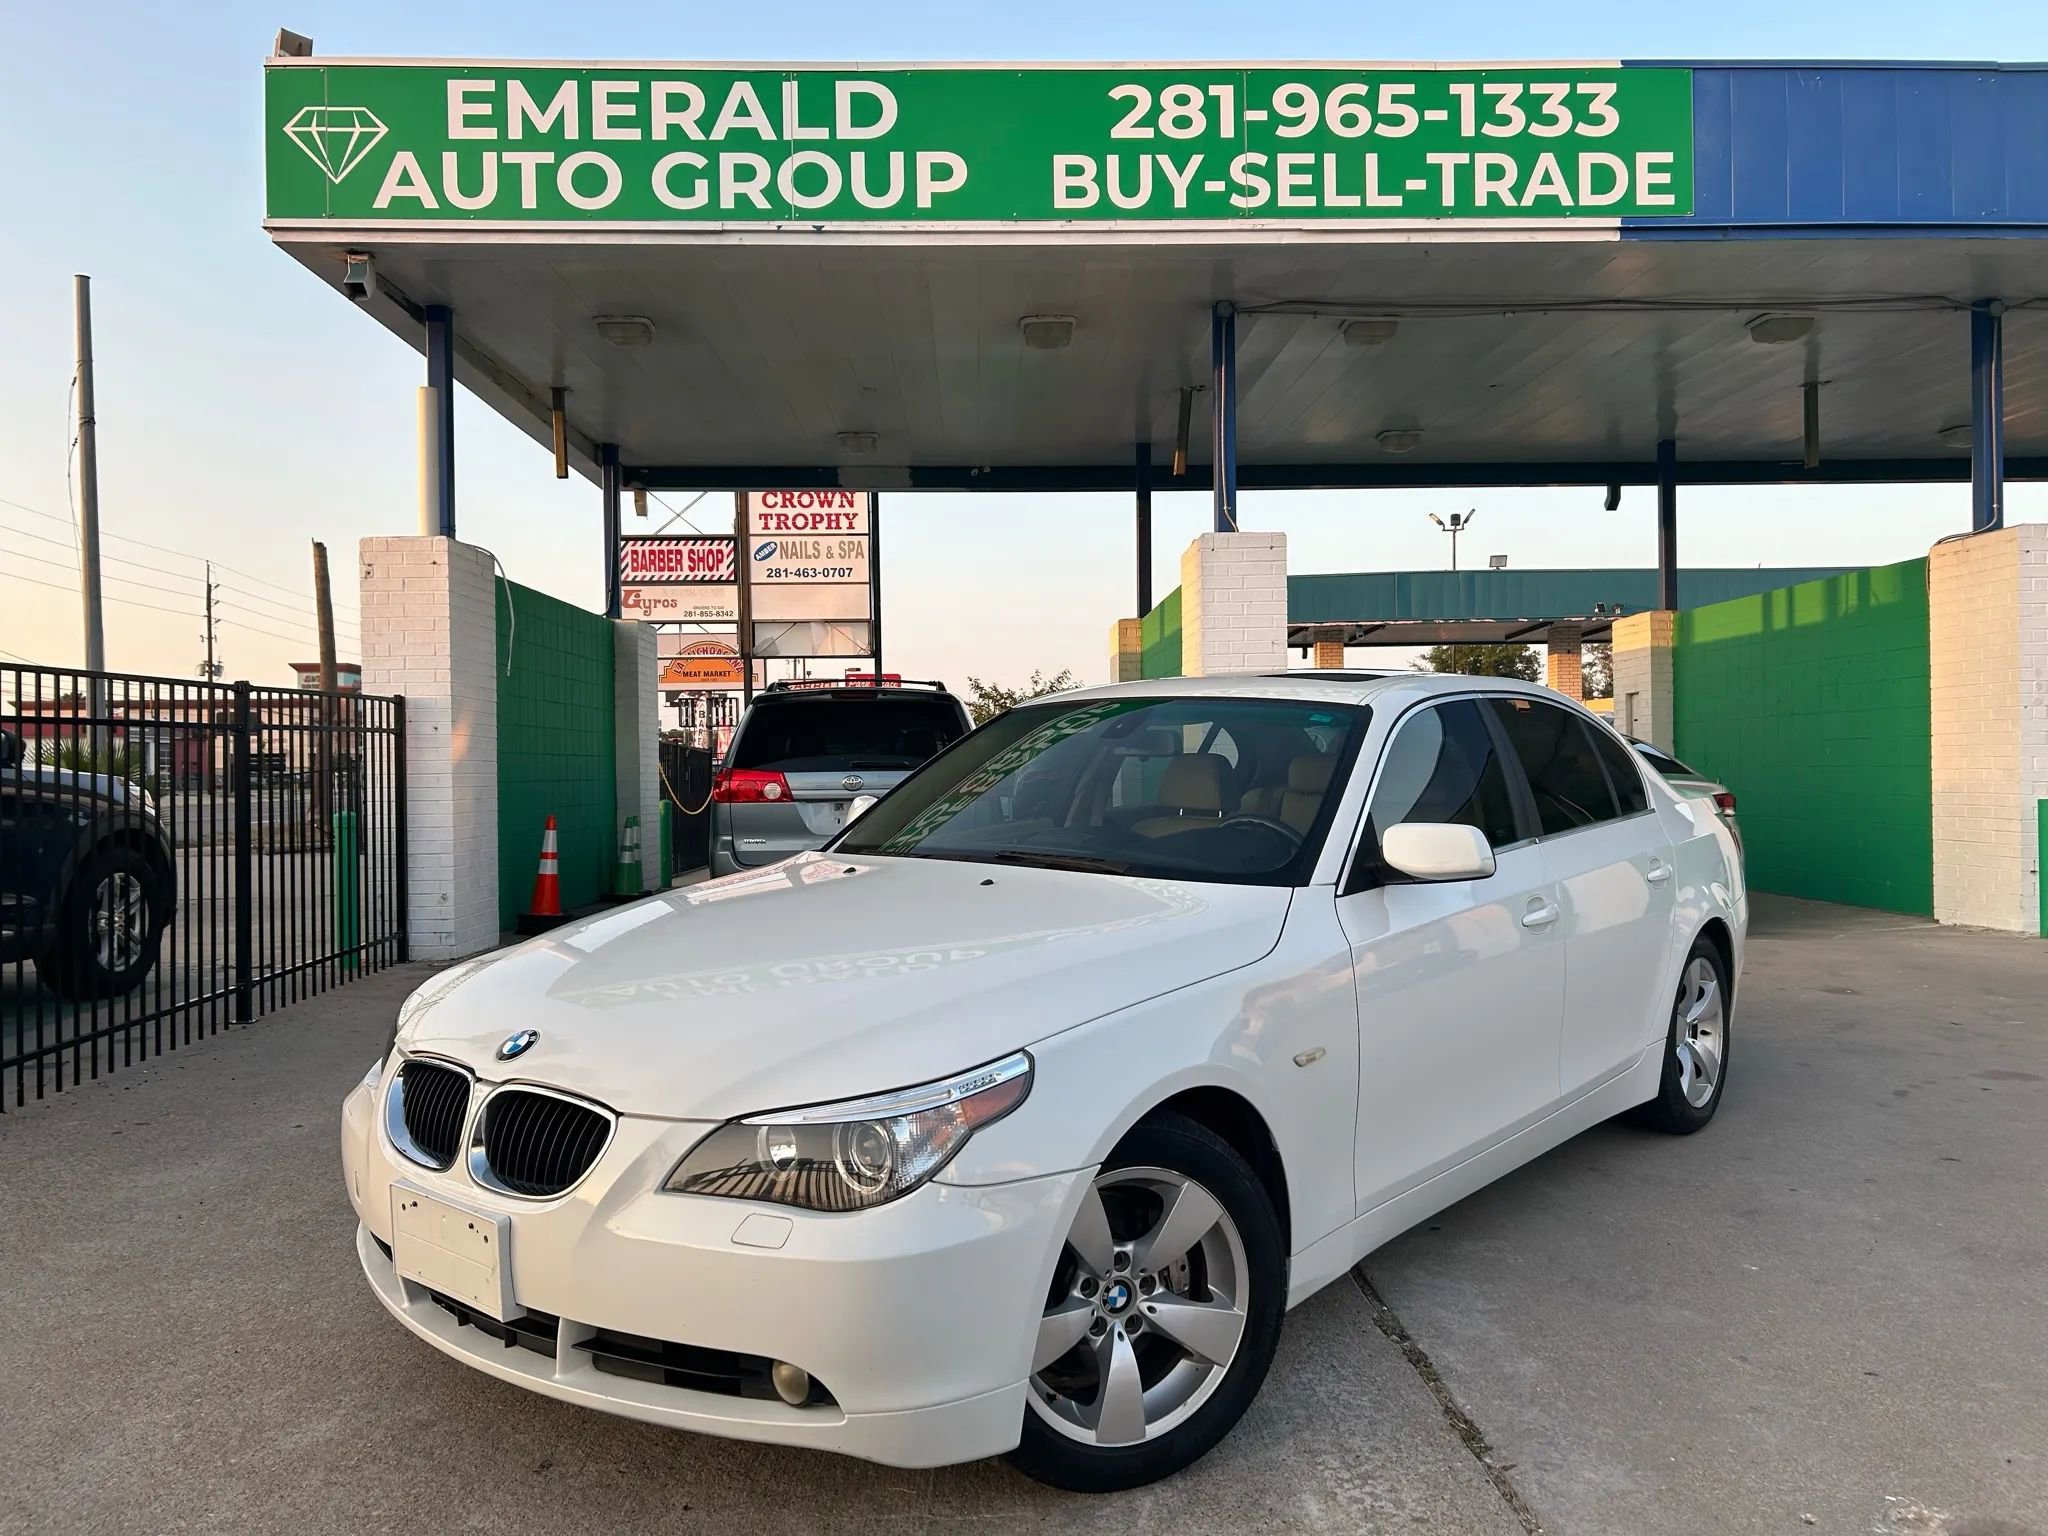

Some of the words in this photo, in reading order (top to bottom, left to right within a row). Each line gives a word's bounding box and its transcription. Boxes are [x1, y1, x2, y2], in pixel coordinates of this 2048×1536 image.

[446, 79, 899, 140] EMERALD
[1107, 82, 1620, 139] 281-965-1333
[372, 151, 623, 209] AUTO
[651, 151, 968, 210] GROUP
[1052, 151, 1676, 208] BUY-SELL-TRADE
[762, 490, 856, 508] CROWN
[759, 513, 858, 530] TROPHY
[630, 549, 683, 572] BARBER
[687, 548, 724, 572] SHOP
[755, 542, 777, 560] AMBER
[780, 541, 820, 559] NAILS
[826, 545, 834, 559] &
[838, 540, 865, 559] SPA
[766, 567, 853, 578] 281-463-0707
[621, 590, 677, 616] Gyros
